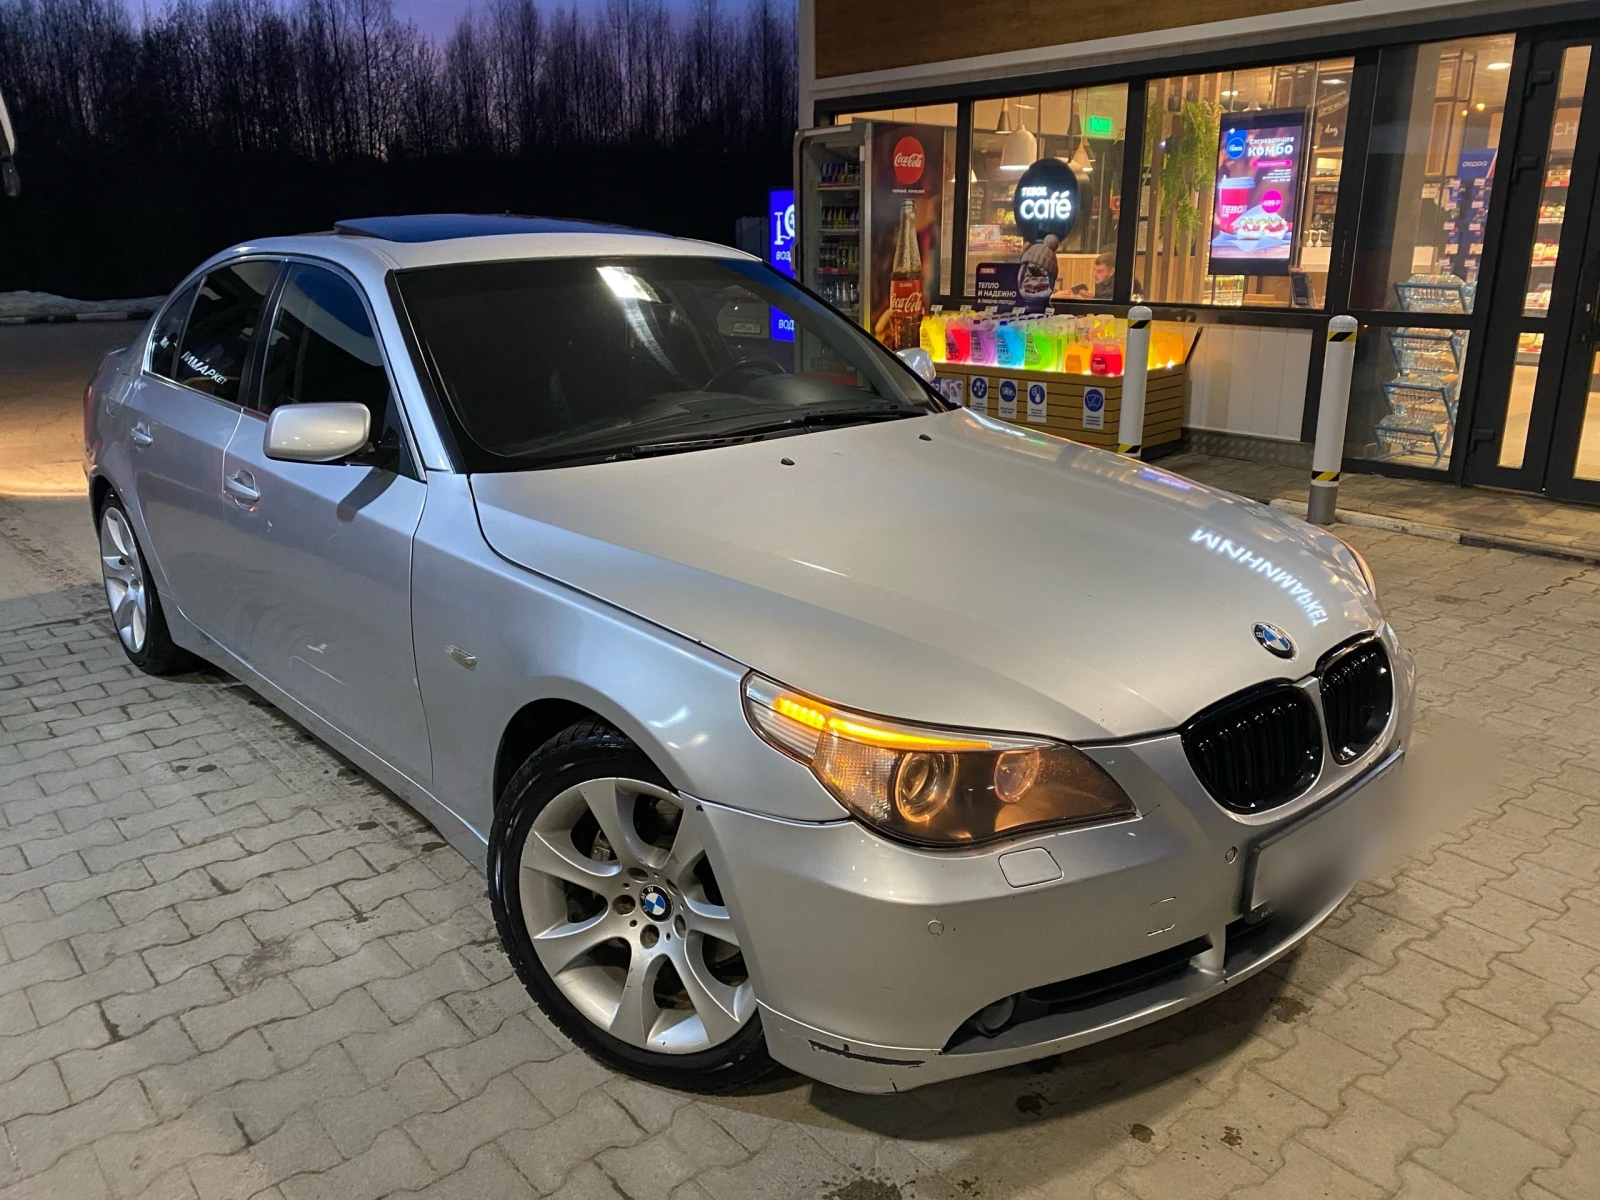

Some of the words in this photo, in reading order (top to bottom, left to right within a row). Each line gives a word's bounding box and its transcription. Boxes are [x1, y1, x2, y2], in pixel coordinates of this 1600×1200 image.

[1247, 142, 1294, 157] комбо
[1462, 160, 1488, 168] deppa
[1020, 190, 1072, 220] café
[775, 250, 791, 262] ВОЗ
[983, 290, 1017, 298] НАДЕЖНО
